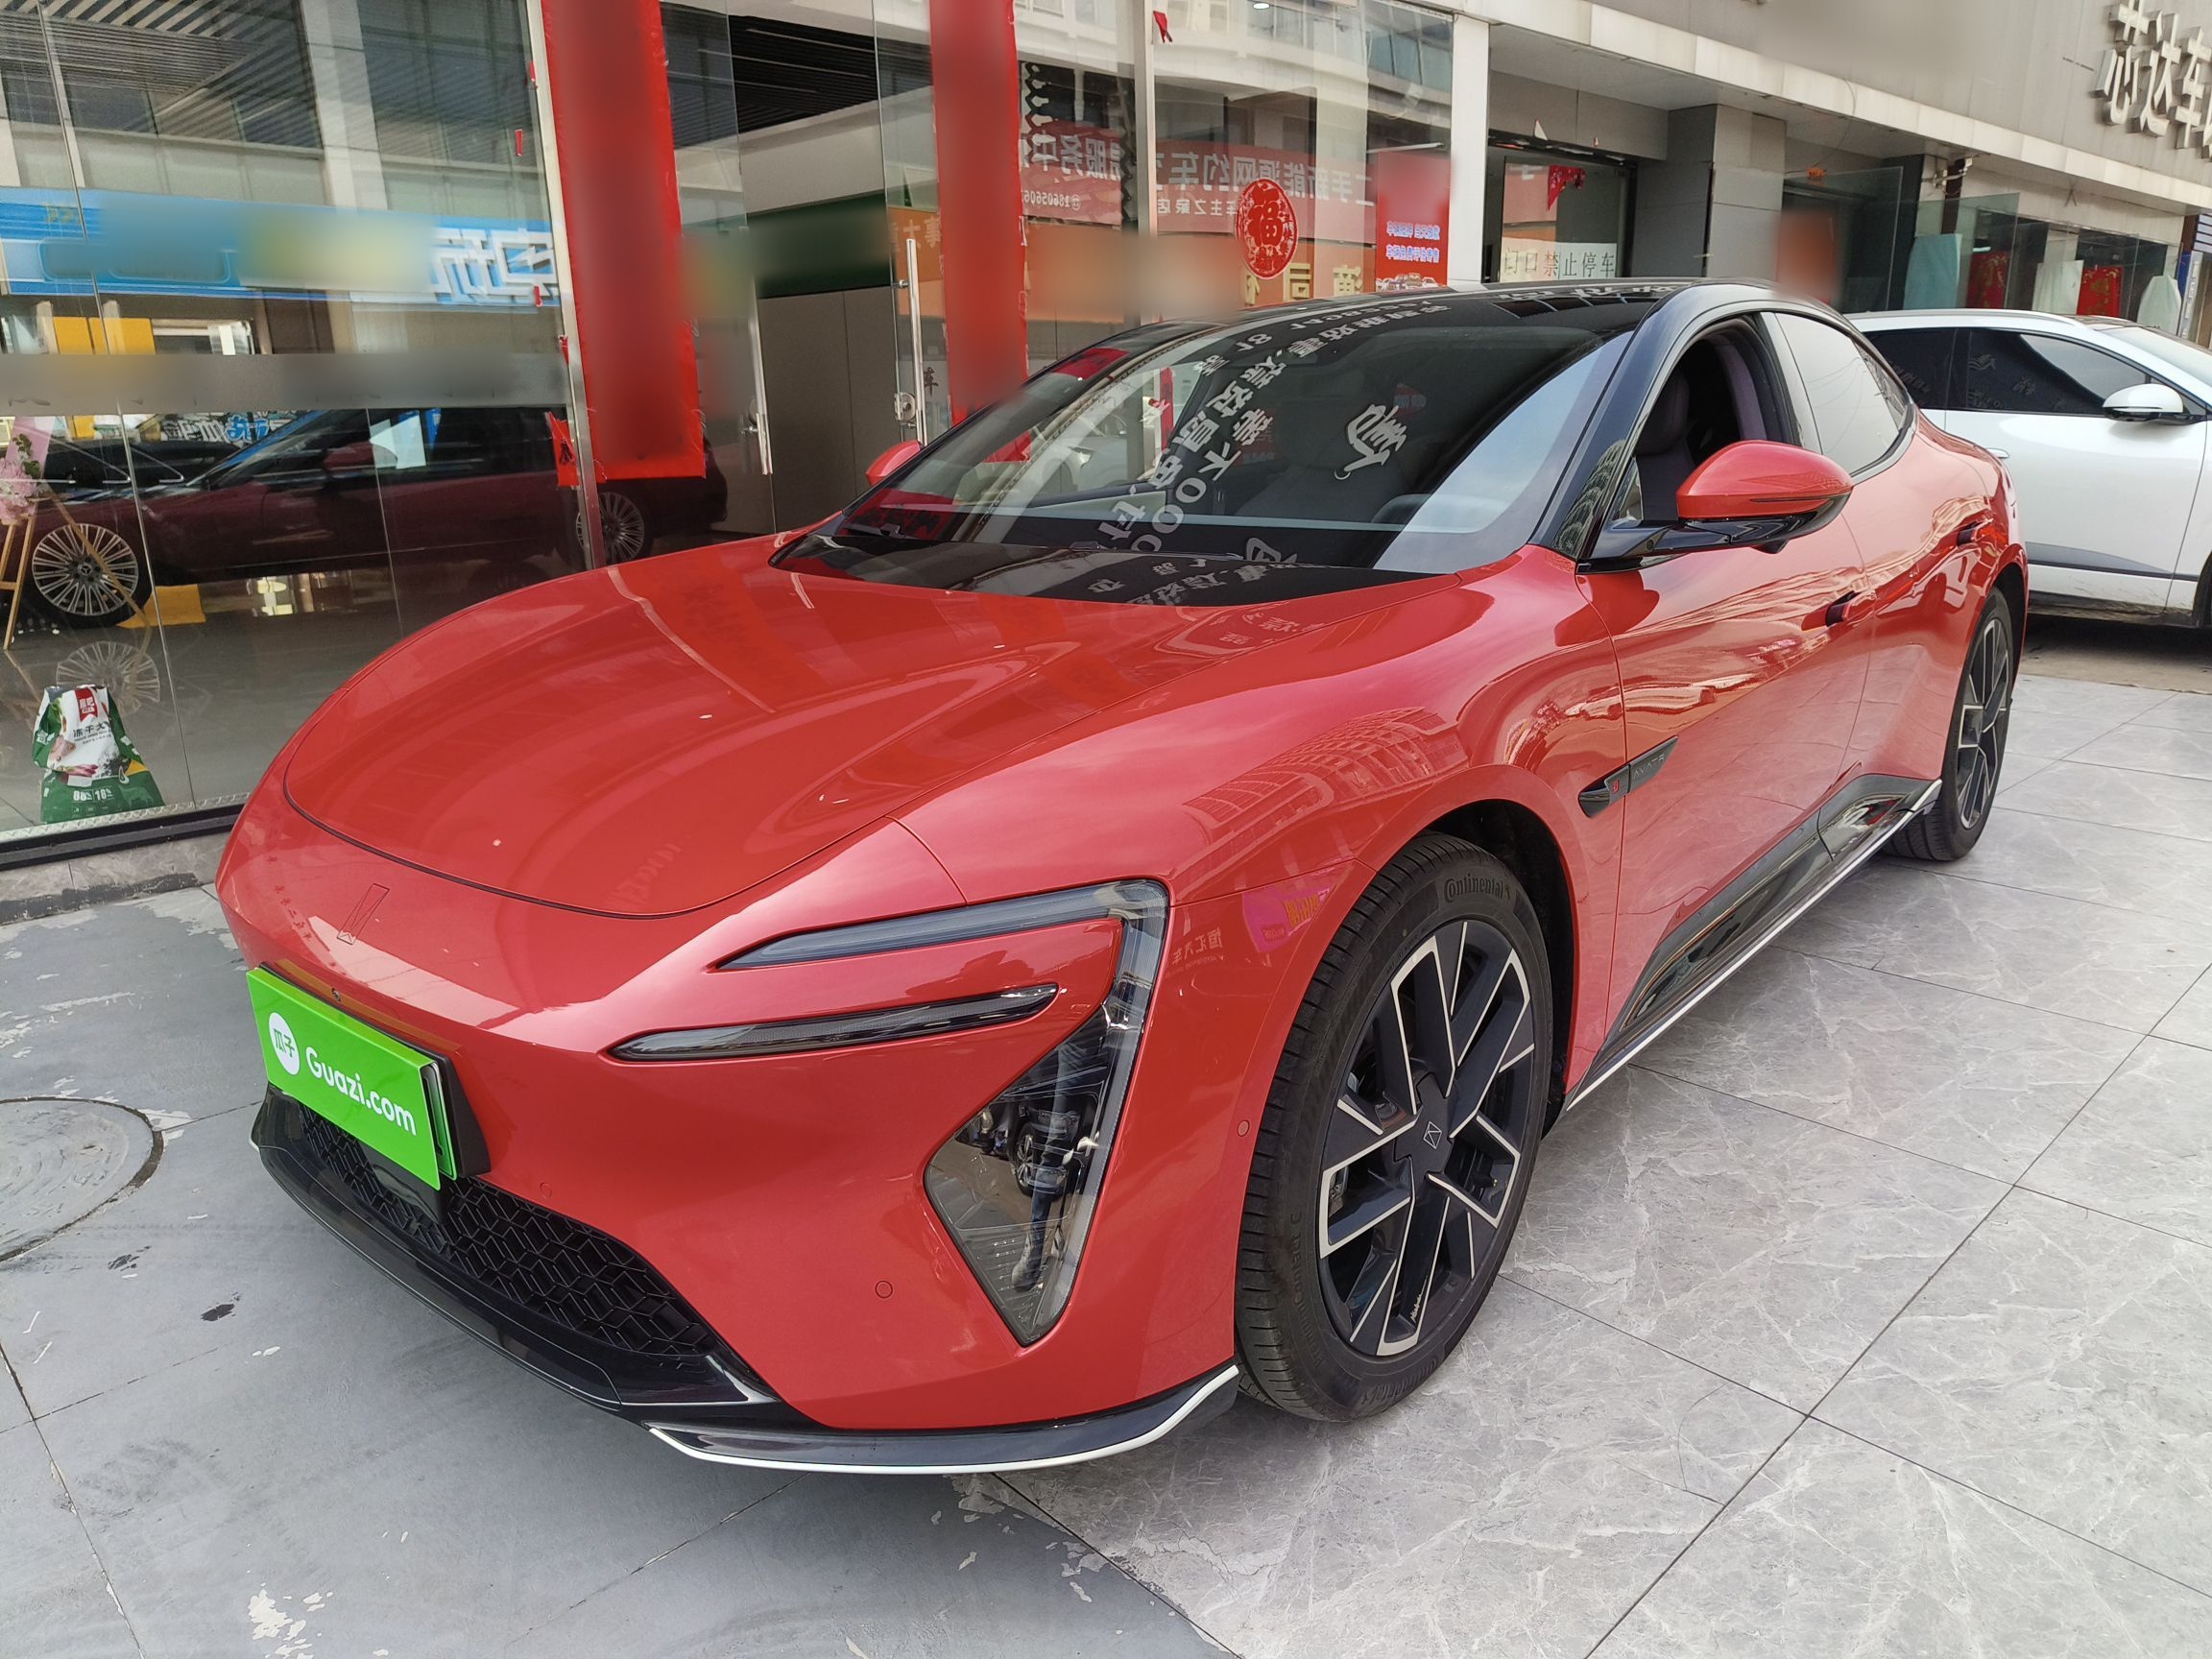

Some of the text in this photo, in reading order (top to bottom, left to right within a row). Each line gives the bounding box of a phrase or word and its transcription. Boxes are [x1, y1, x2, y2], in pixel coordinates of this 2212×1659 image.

[2103, 0, 2212, 159] 芯达车
[1504, 247, 1615, 278] 门口禁止停车
[1443, 873, 1503, 903] Continental
[305, 1046, 417, 1137] Guazi.com
